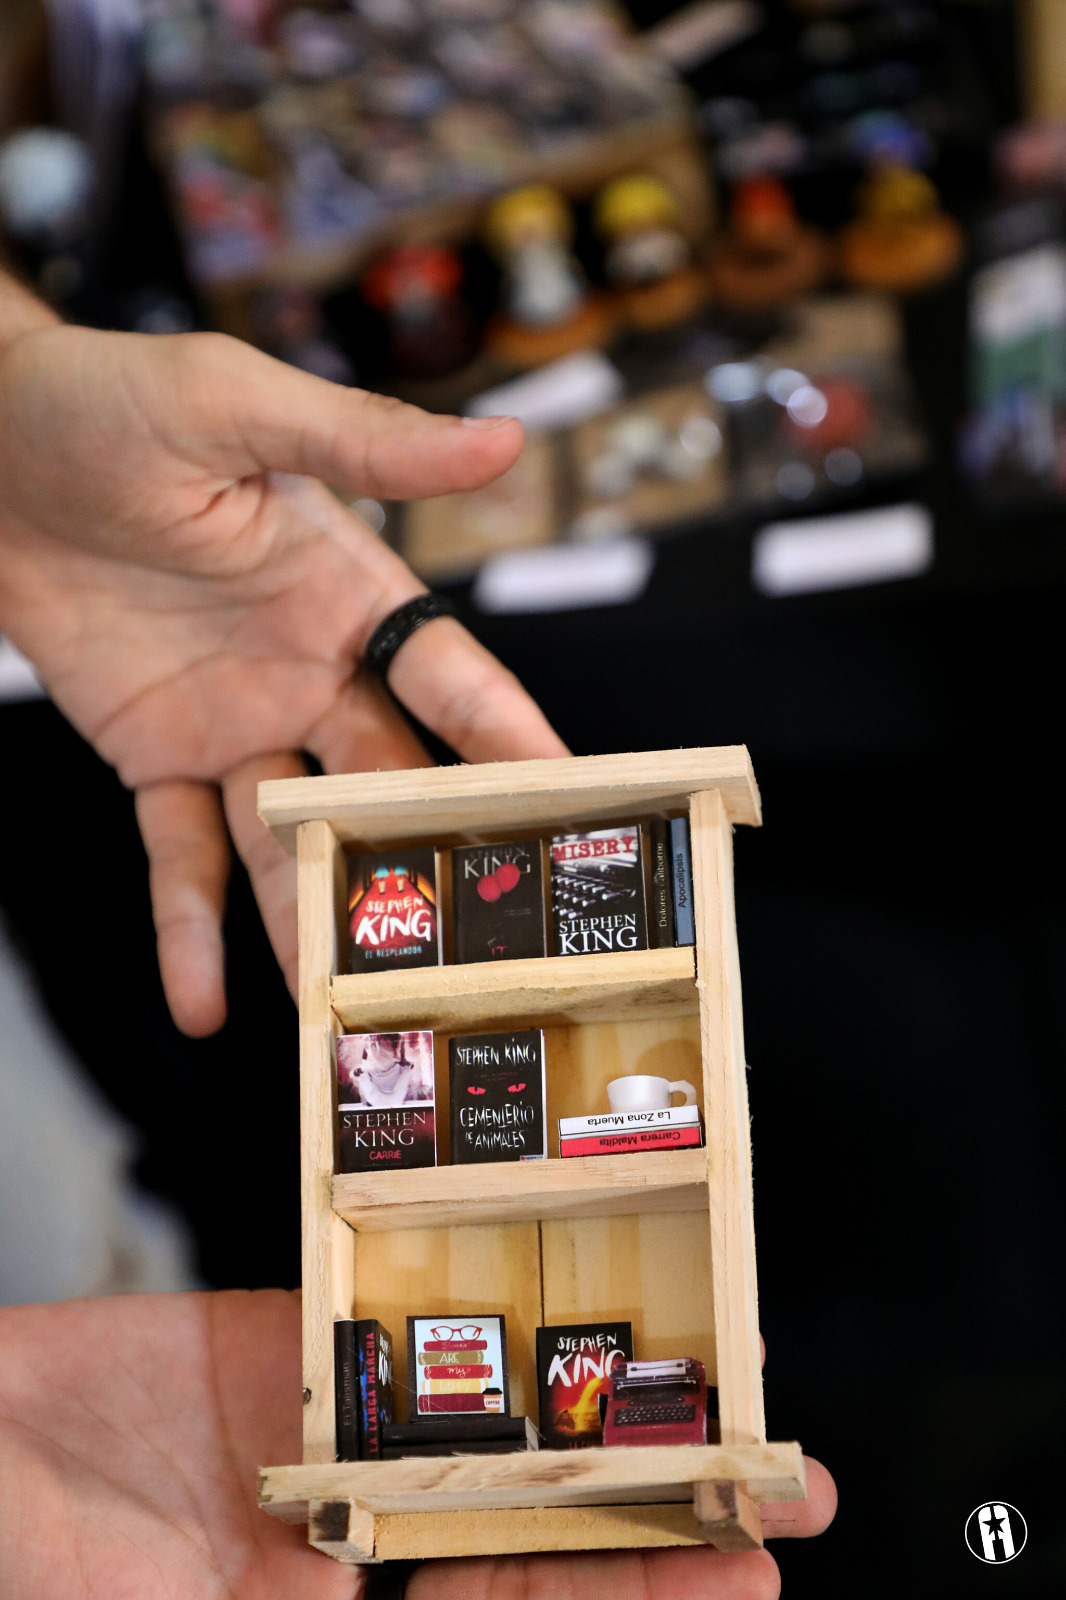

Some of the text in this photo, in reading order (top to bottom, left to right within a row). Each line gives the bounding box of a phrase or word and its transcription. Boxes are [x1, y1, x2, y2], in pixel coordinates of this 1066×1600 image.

[553, 836, 635, 862] MISERY
[464, 852, 532, 879] KING
[676, 853, 687, 908] Apocalipsis
[366, 895, 424, 914] STEPHEN
[659, 889, 668, 927] Dolores
[355, 907, 431, 945] KING
[559, 913, 636, 933] STEPHEN
[559, 926, 638, 955] KING
[365, 946, 422, 959] EL RESPLANDOR
[457, 1036, 536, 1067] STEPHEN KING
[343, 1111, 426, 1129] STEPHEN
[460, 1101, 534, 1129] CEMENTERIO
[587, 1111, 671, 1126] La Zona Muerta
[355, 1128, 414, 1148] KING
[474, 1129, 526, 1152] ANIMALES
[599, 1132, 681, 1146] Carrera Maldita
[369, 1149, 402, 1160] CARRIE
[557, 1333, 617, 1353] STEPHEN
[439, 1352, 460, 1363] ARE
[366, 1332, 378, 1453] LA LARGA MARCHA
